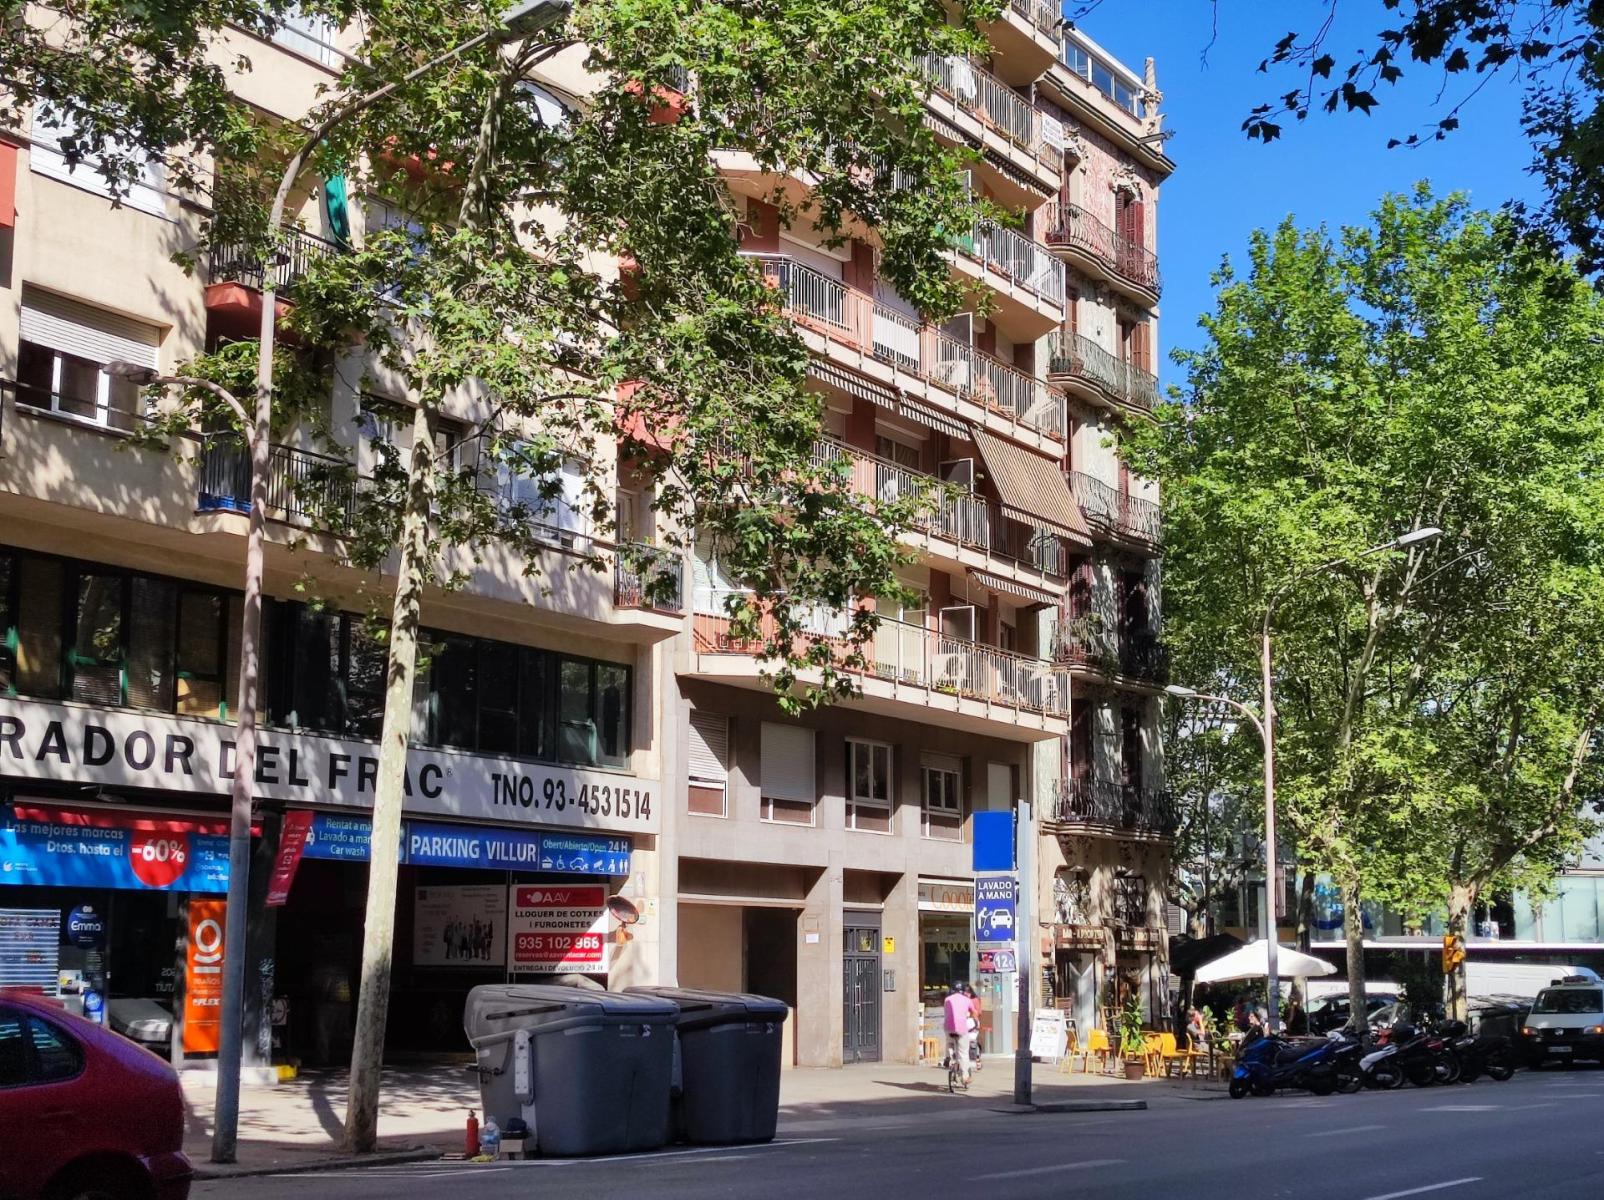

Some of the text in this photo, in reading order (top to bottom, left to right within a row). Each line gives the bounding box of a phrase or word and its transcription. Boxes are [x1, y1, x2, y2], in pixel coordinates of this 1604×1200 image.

[0, 715, 195, 776] RADOR
[218, 740, 309, 787] DEL
[491, 773, 539, 808] TNO.
[7, 820, 124, 840] Las mejores marcas
[326, 817, 352, 830] Rentat
[353, 823, 359, 831] a
[319, 830, 348, 841] Lavado
[349, 835, 354, 843] a
[47, 840, 123, 857] Dtos. hasta el
[131, 838, 185, 863] -60%
[330, 843, 366, 857] Car wash
[410, 835, 537, 863] PARKING VILLUR
[608, 841, 620, 853] 24
[621, 842, 628, 853] H
[978, 881, 1012, 900] LAVADO A MANO
[515, 910, 605, 918] LLOGUER DE COTXES
[70, 920, 101, 932] Emma
[534, 921, 593, 929] FURGONETES
[518, 936, 543, 949] 935
[547, 936, 571, 949] 102
